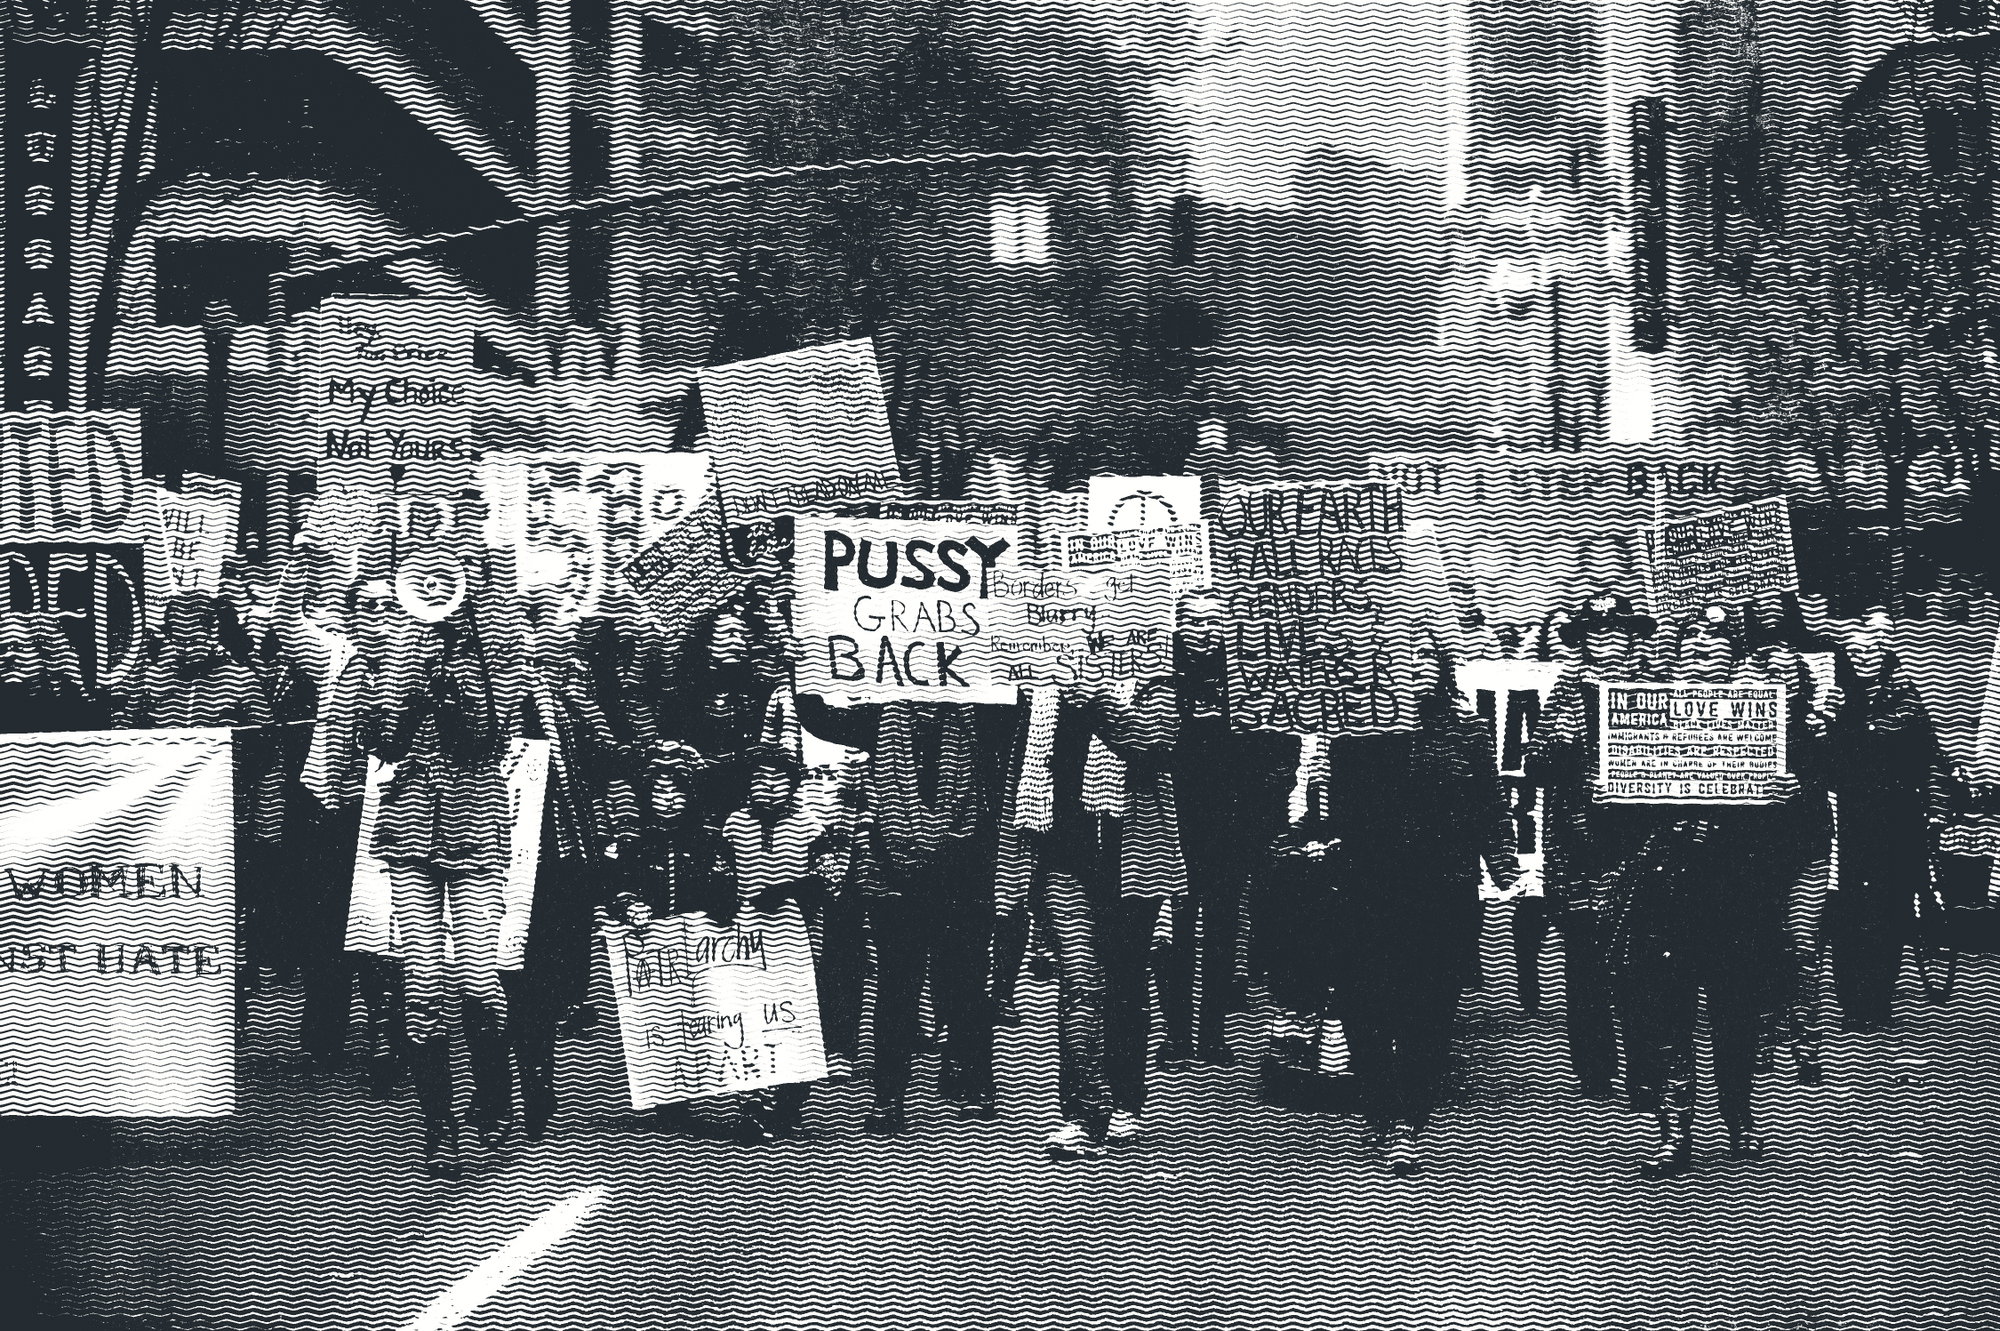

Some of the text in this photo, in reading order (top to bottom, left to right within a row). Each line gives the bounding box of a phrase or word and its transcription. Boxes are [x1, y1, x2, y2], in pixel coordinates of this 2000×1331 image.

[329, 377, 378, 423] My
[0, 416, 134, 533] TED
[1626, 462, 1722, 498] BACK
[1218, 483, 1403, 538] OUR EARTH
[824, 530, 1011, 599] PUSSY
[993, 572, 1078, 599] Borders
[853, 596, 981, 636] GRABS
[1026, 603, 1097, 634] Blurry
[828, 635, 971, 687] BACK
[1610, 691, 1669, 710] IN OUR
[1673, 690, 1775, 699] ALL PEOPLE ARE EQUAL
[1674, 701, 1777, 718] LOVE WINS
[1611, 712, 1668, 726] AMERICA
[1608, 732, 1660, 741] IMMIGRANTS
[1718, 733, 1734, 742] ARE
[1736, 733, 1777, 742] WELCOME
[1608, 759, 1637, 768] WOMEN
[1641, 759, 1657, 768] ARE
[1660, 760, 1669, 768] IN
[1722, 760, 1746, 769] THEIR
[1607, 782, 1764, 795] DIVERSITY IS CELEBRAT
[4, 863, 204, 900] WOMEN
[97, 943, 222, 976] HATE
